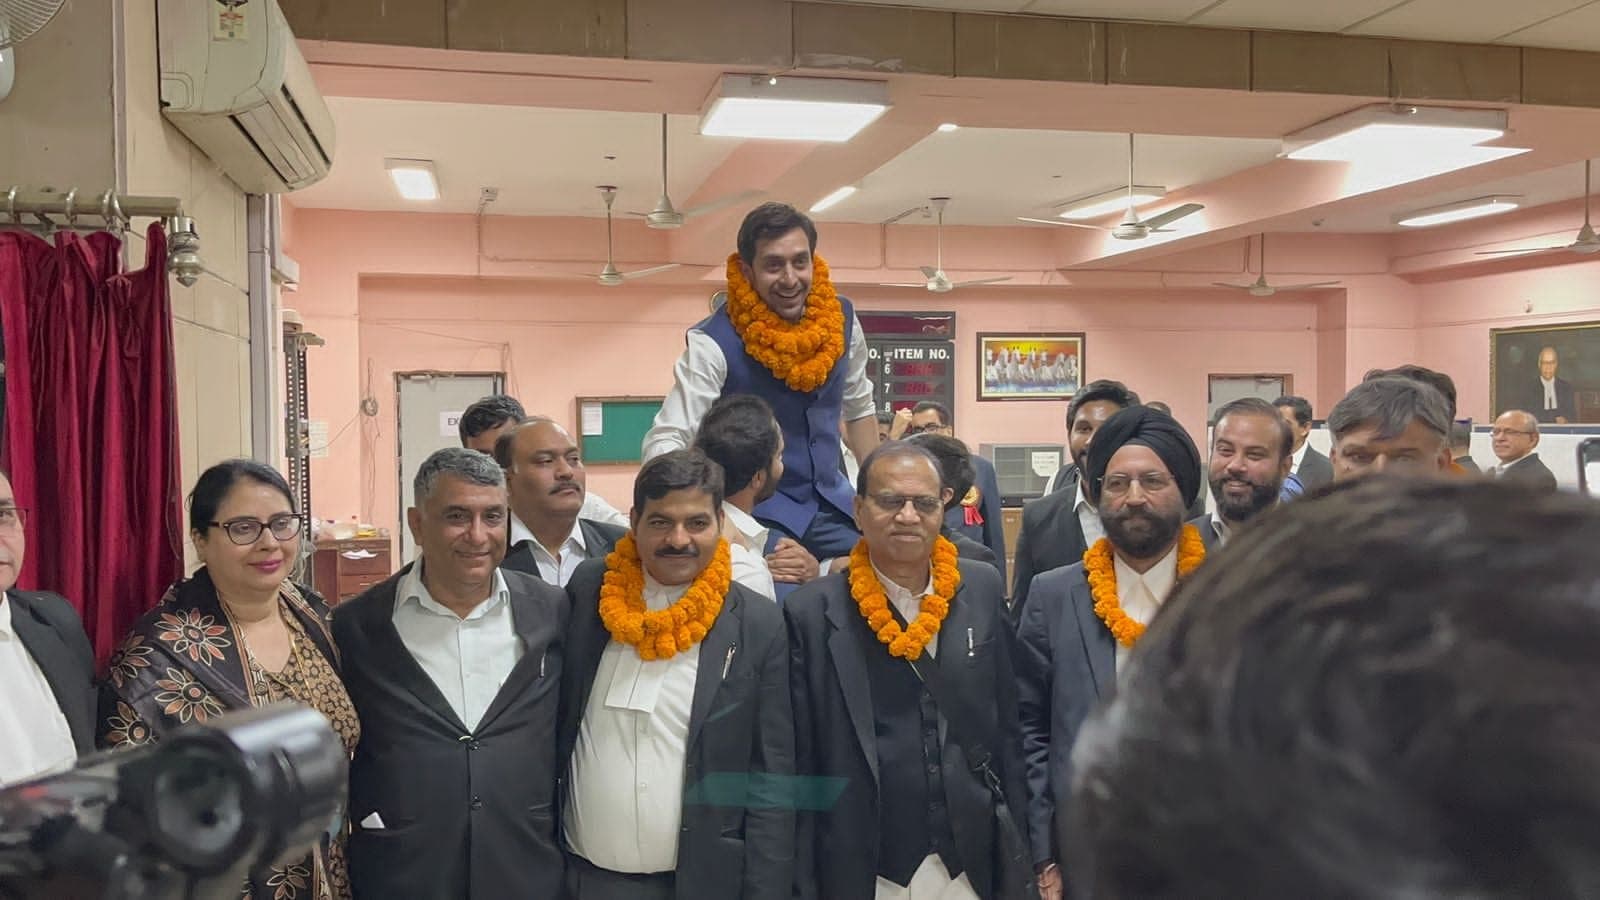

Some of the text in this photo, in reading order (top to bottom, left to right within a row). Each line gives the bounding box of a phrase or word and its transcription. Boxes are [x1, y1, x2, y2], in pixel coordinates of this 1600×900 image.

[869, 348, 881, 360] O.
[894, 348, 923, 360] ITEM
[929, 348, 950, 360] NO.
[884, 363, 891, 374] 6
[884, 383, 891, 394] 7
[884, 402, 891, 412] 8
